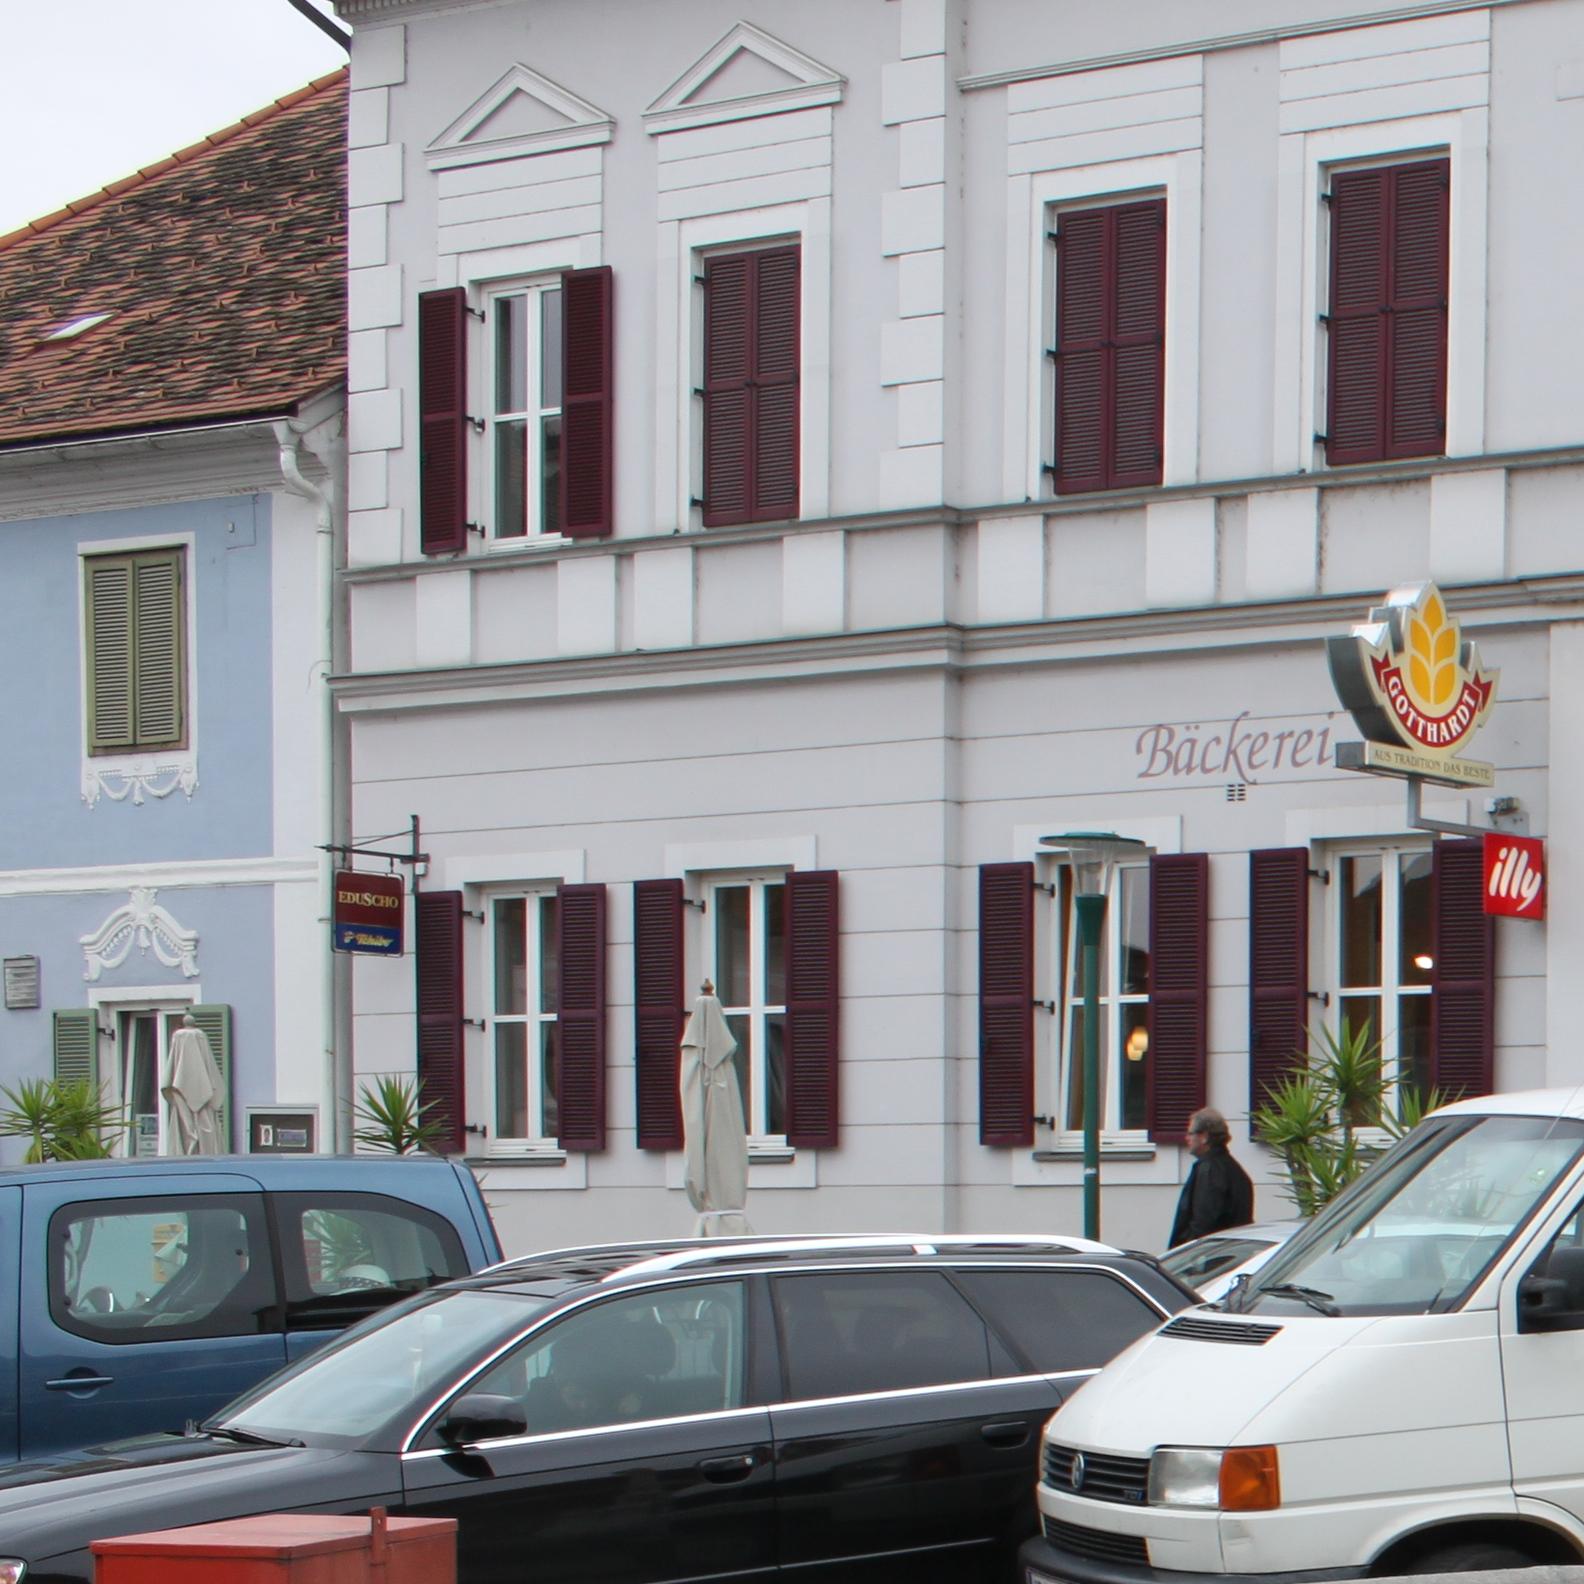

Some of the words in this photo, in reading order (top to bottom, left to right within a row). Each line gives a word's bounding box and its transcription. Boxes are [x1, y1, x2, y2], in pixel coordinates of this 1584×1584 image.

[1387, 675, 1476, 743] GOTTHARDT
[1135, 710, 1333, 785] Bäckerei
[1374, 749, 1392, 762] AUS
[1394, 752, 1442, 770] TRADITION
[1443, 761, 1461, 775] DAS
[1463, 764, 1490, 780] BESTE
[338, 890, 399, 909] EDUSCHO
[1489, 846, 1542, 912] illy
